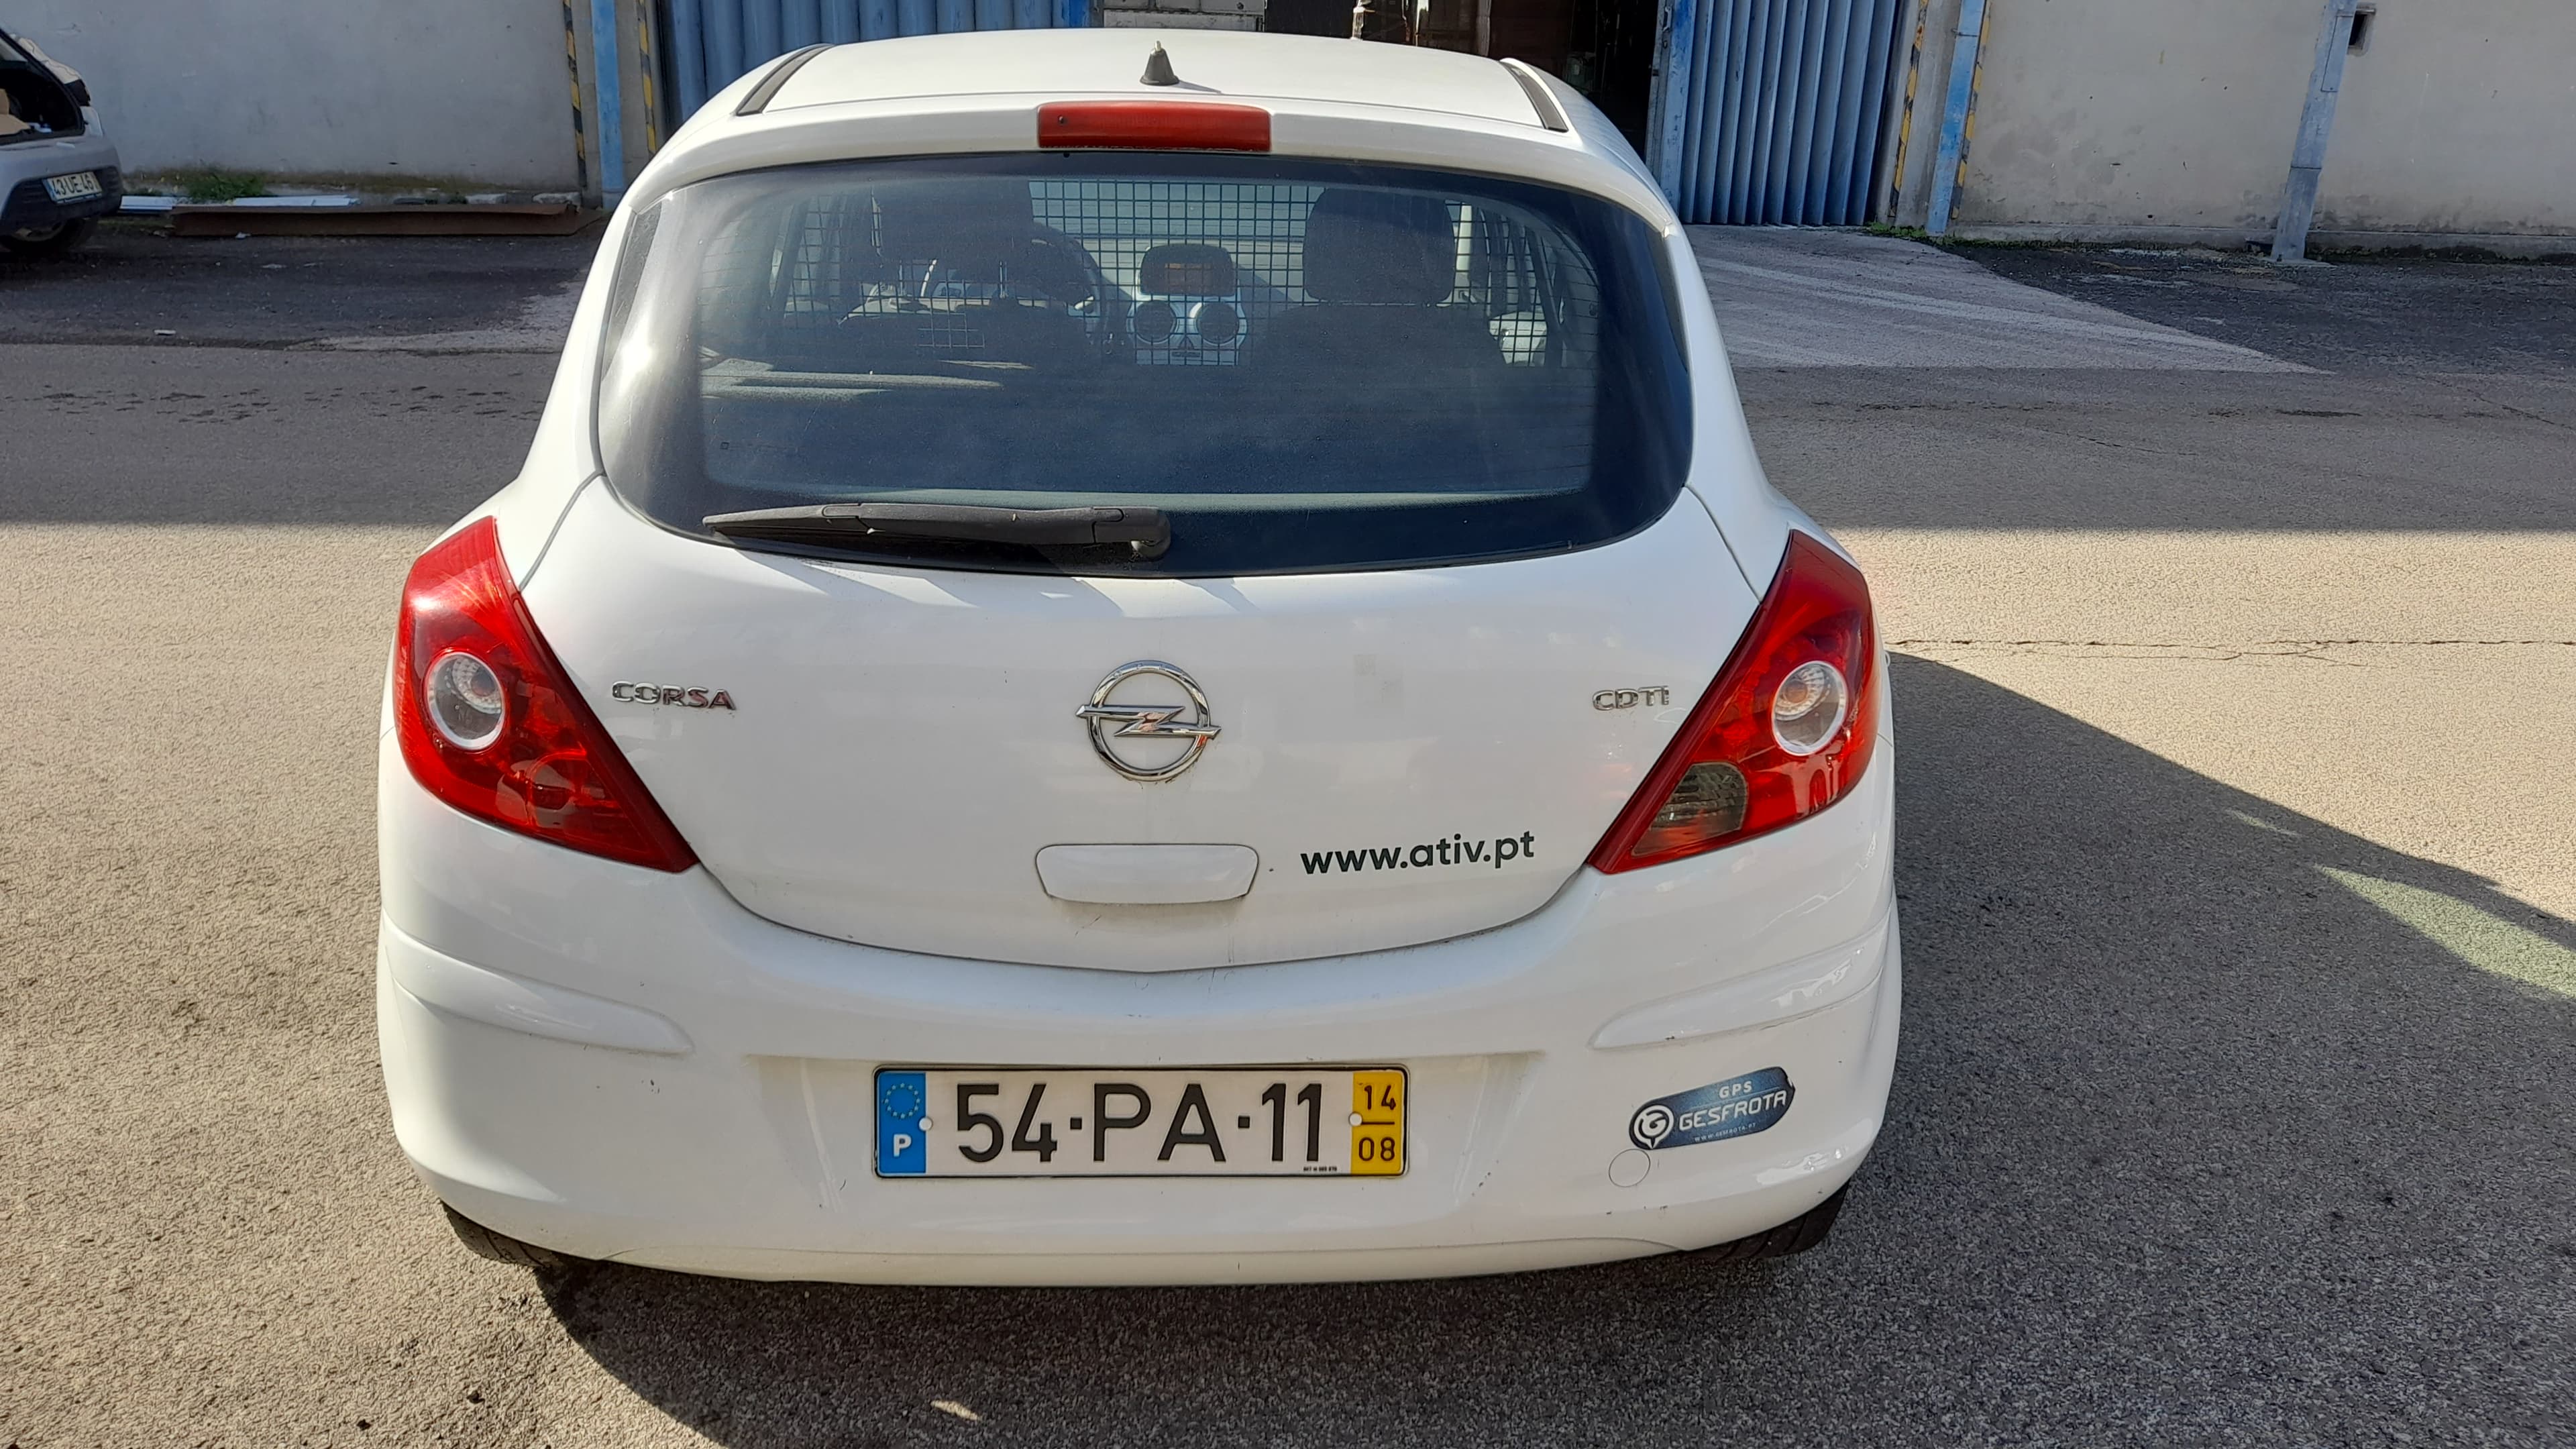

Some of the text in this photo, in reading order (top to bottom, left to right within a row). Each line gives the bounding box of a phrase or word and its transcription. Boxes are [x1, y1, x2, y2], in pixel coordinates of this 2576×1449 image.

[612, 680, 737, 710] CORSA
[1593, 685, 1669, 711] CDTI
[1300, 830, 1535, 874] www.ativ.pt
[1364, 1085, 1397, 1110] 14
[1719, 1081, 1752, 1099] GPS
[1678, 1090, 1787, 1131] GESFROTA
[894, 1134, 912, 1157] P
[1358, 1136, 1395, 1161] 08
